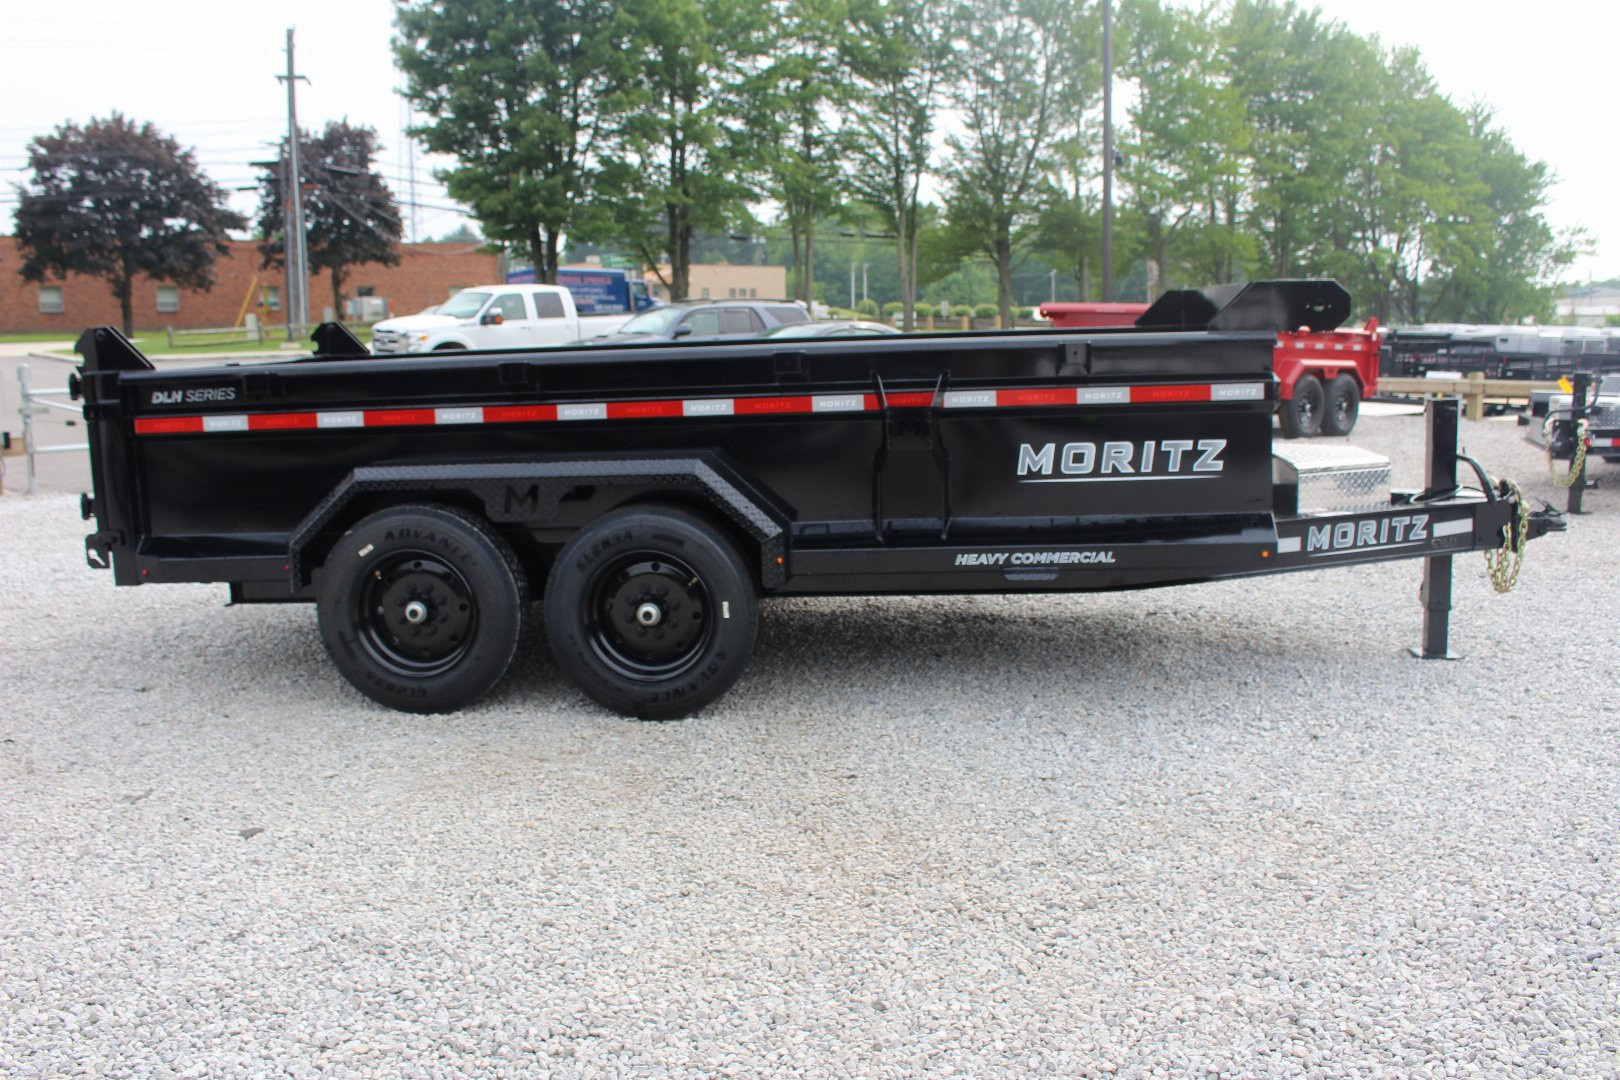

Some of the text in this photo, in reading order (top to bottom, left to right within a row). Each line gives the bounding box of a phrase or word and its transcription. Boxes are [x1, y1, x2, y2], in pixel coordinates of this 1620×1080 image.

[151, 387, 236, 405] DLH SERIES
[323, 415, 357, 424] MORITZ
[441, 411, 477, 421] MORITZ
[563, 407, 599, 417] MORITZ
[690, 403, 727, 413] MORITZ
[819, 398, 857, 408] MORITZ
[951, 394, 990, 404] MORITZ
[1084, 391, 1123, 401] MORITZ
[1218, 387, 1257, 397] MORITZ
[1016, 438, 1228, 475] MORITZ
[503, 484, 540, 514] M
[383, 528, 472, 563] ADVANCE
[1307, 514, 1430, 552] MORITZ
[955, 551, 1116, 567] HEAVY COMMERCIAL
